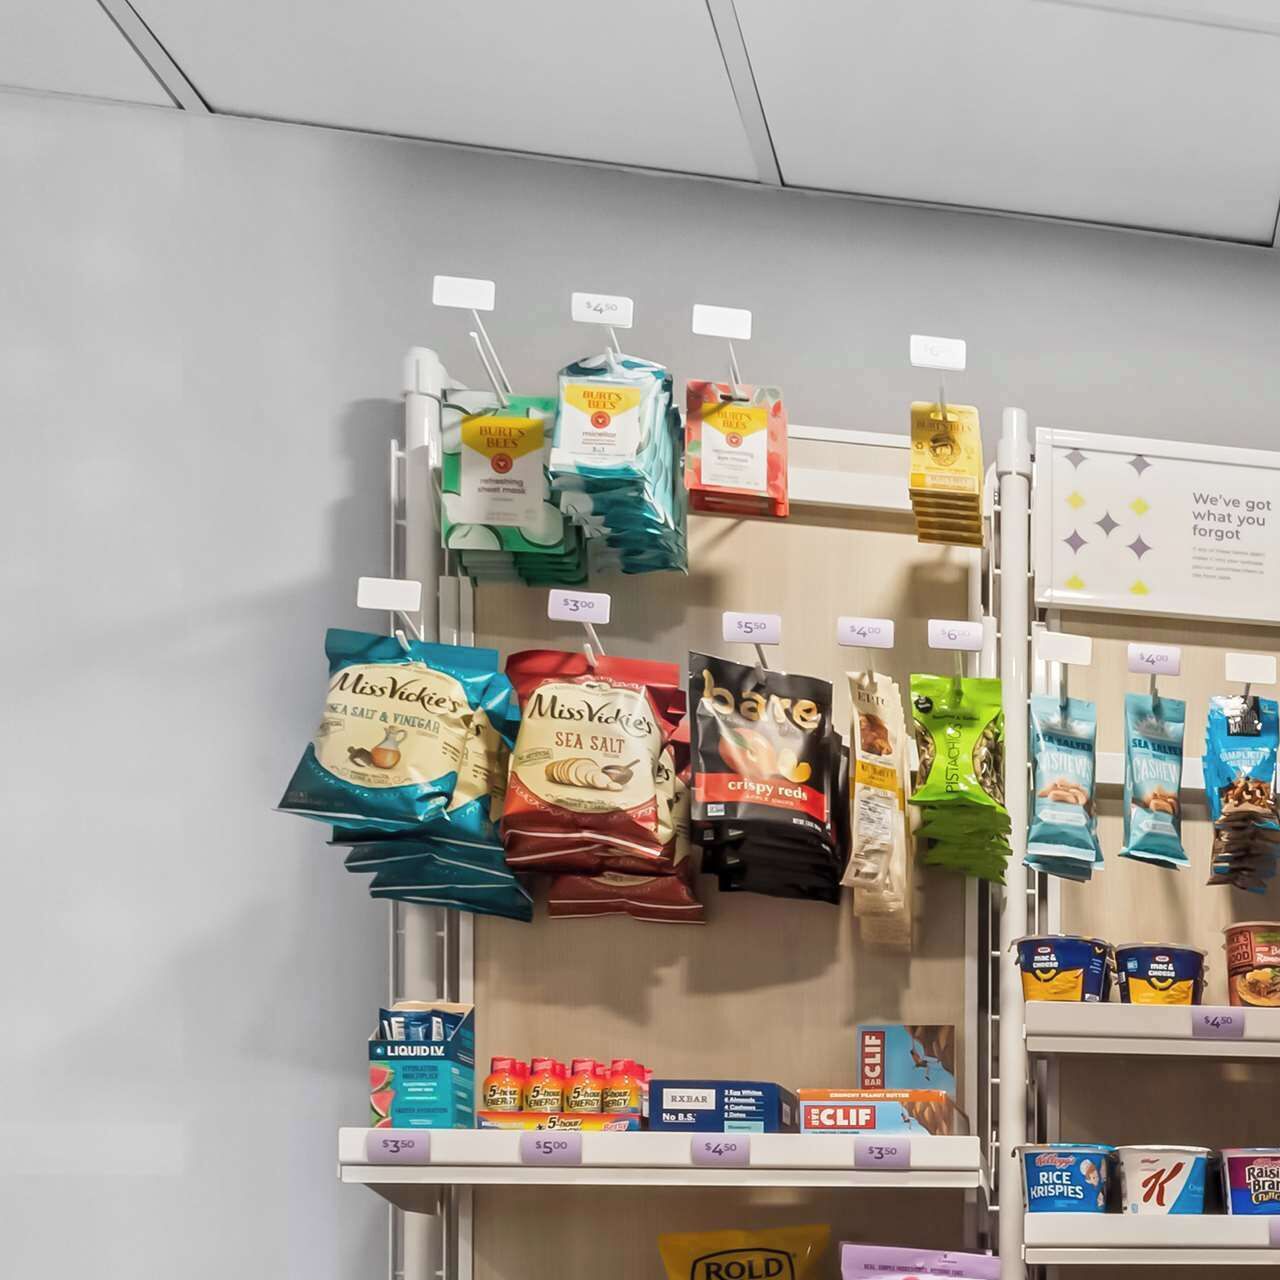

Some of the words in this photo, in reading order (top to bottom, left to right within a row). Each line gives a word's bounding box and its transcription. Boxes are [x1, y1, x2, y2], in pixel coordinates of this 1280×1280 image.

[1192, 492, 1240, 508] We've
[1246, 499, 1271, 511] got
[1192, 510, 1232, 523] what
[1238, 514, 1265, 527] you
[1192, 525, 1240, 540] forgot
[331, 672, 389, 697] Miss
[388, 676, 462, 715] Vickie's
[702, 669, 823, 731] bare
[351, 707, 377, 722] SALT
[380, 713, 388, 723] &
[393, 713, 440, 734] VINEGAR
[528, 694, 585, 721] Miss
[584, 700, 653, 738] Vickie's
[555, 731, 584, 749] SEA
[591, 736, 625, 753] SALT
[728, 780, 774, 798] crispy
[778, 787, 808, 801] reds
[864, 1034, 881, 1078] CLIF
[864, 1078, 881, 1086] BAR
[528, 1098, 560, 1107] ENERGY
[671, 1095, 708, 1103] RXBAR
[663, 1113, 676, 1121] No
[820, 1108, 871, 1126] CLIF
[1035, 1154, 1075, 1166] Kellogg's
[1039, 1172, 1071, 1184] RICE
[1141, 1162, 1186, 1207] K
[1030, 1185, 1083, 1199] KRISPIES
